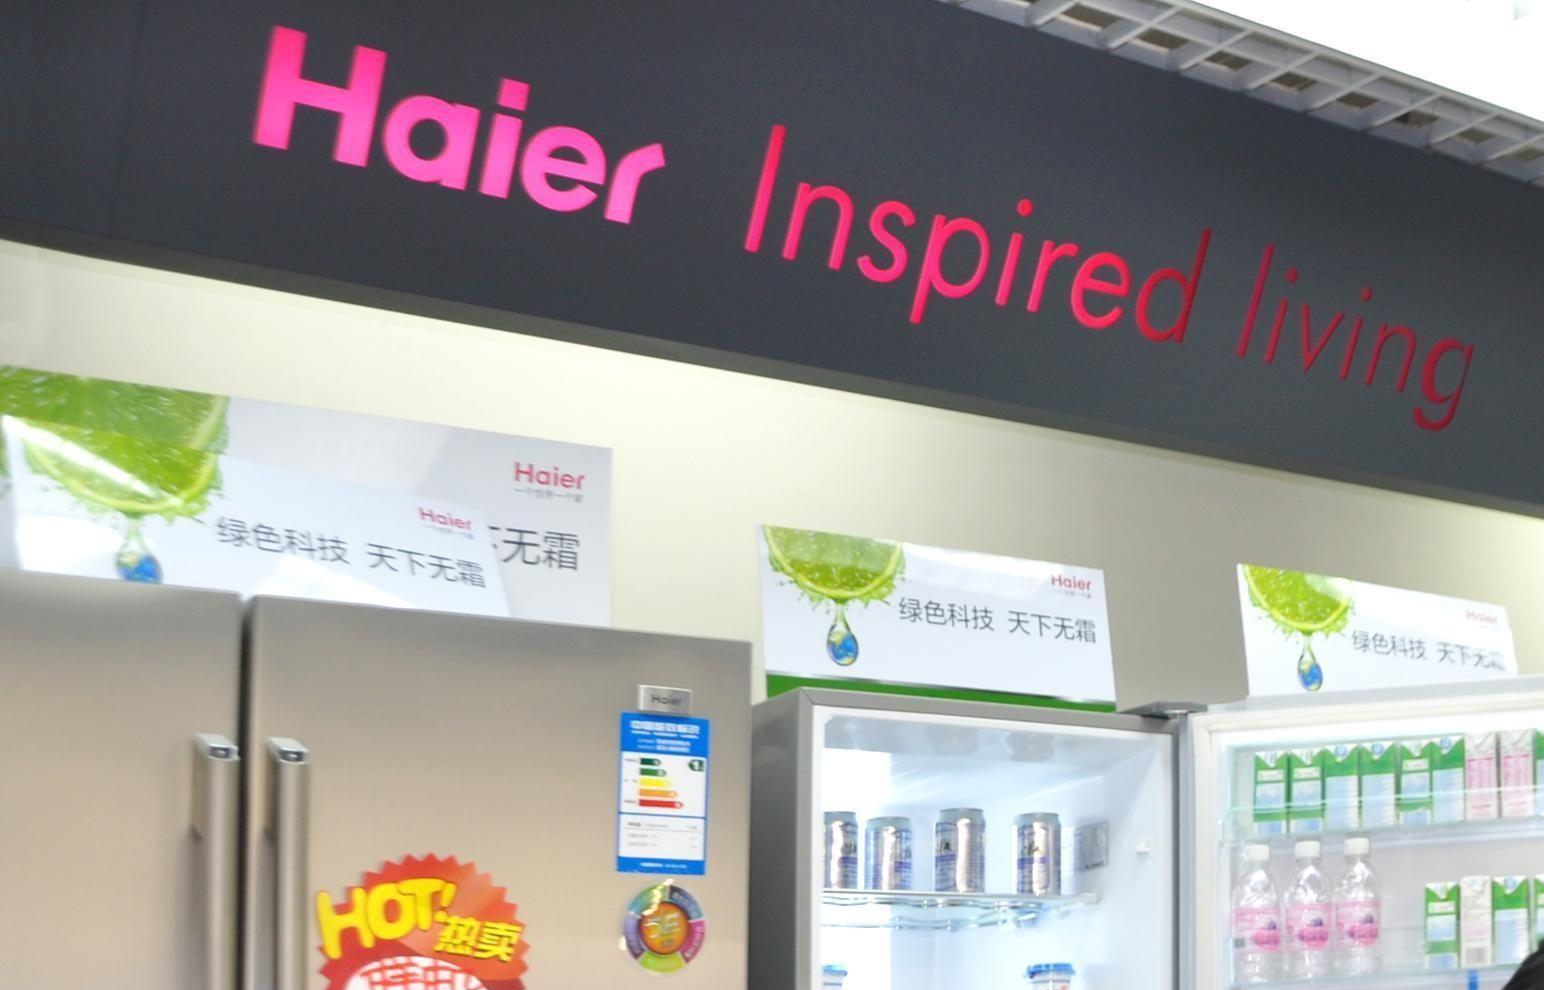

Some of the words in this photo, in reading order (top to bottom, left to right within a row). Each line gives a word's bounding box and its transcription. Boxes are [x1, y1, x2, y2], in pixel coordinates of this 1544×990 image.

[252, 25, 667, 225] Haier
[744, 123, 1211, 343] Inspired
[1237, 243, 1474, 432] living
[512, 461, 586, 491] Haier
[418, 506, 472, 531] Haier
[216, 515, 349, 566] 绿色科技
[367, 543, 486, 588] 天下无霜
[1051, 574, 1092, 591] Haier
[898, 597, 995, 631] 绿色科技
[1007, 610, 1096, 643] 天下无霜
[1352, 629, 1426, 660] 绿色科技
[316, 878, 458, 960] HOT!
[433, 914, 523, 963] 热卖
